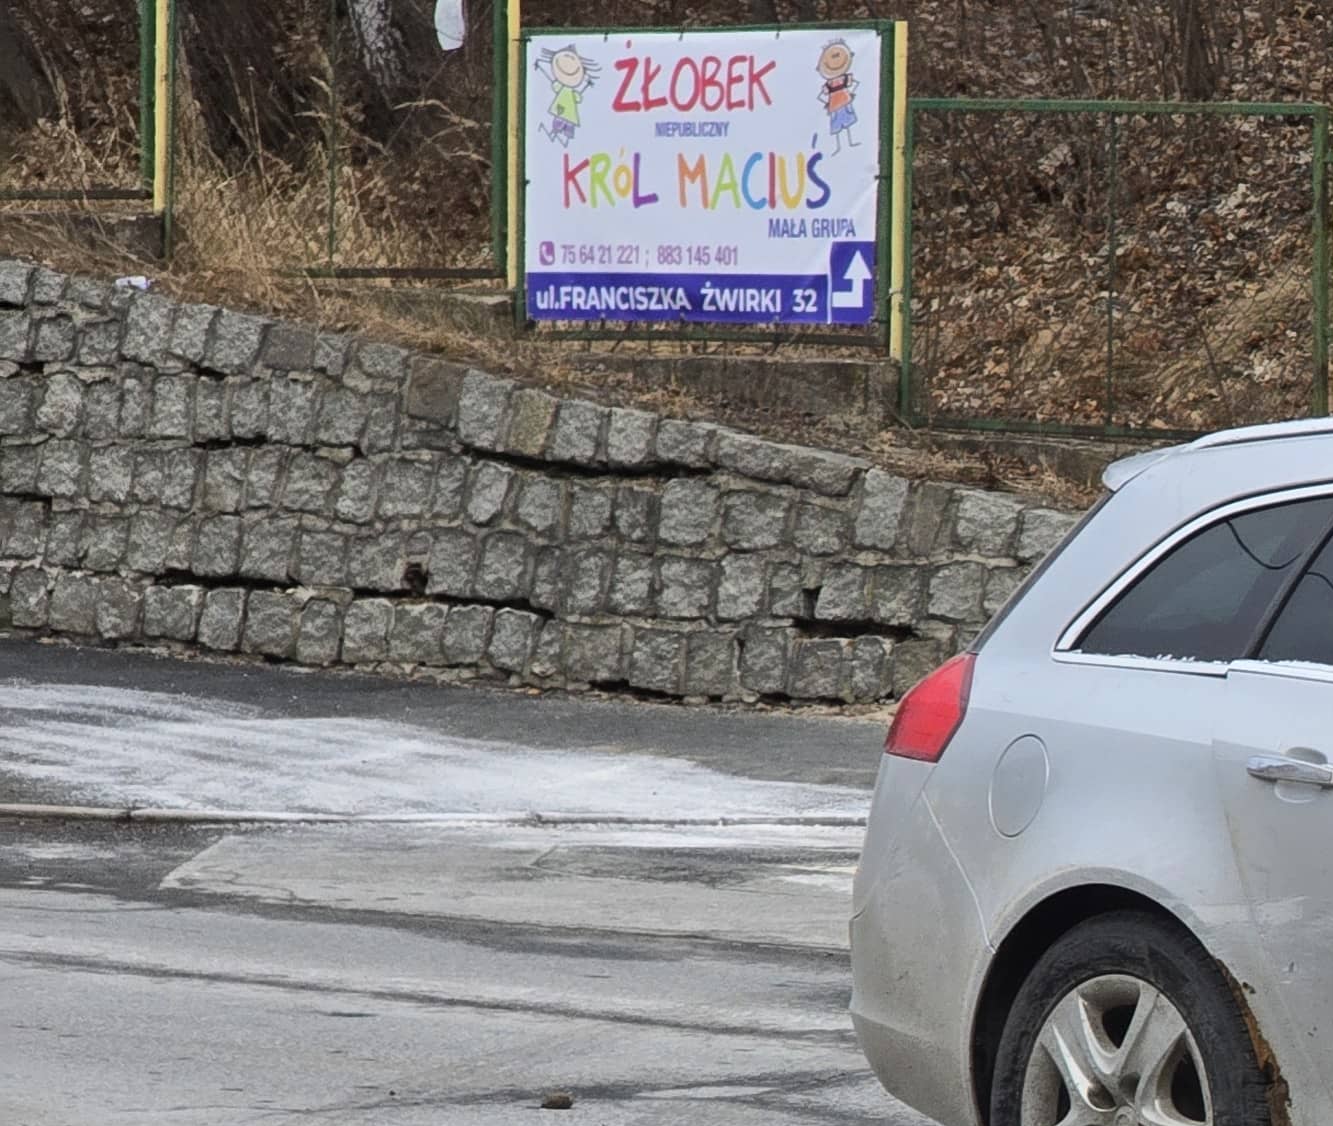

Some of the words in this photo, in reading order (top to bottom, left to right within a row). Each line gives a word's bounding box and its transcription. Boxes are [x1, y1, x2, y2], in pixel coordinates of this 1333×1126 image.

[612, 40, 776, 112] ŻŁOBEK
[654, 121, 730, 137] NIEPUBLICZNY
[563, 148, 659, 209] KRÓL
[676, 133, 831, 210] MACIUŚ
[768, 218, 808, 238] MAŁA
[811, 218, 857, 238] GRUPA
[560, 244, 576, 264] 75
[579, 244, 595, 265] 64
[599, 245, 612, 265] 21
[616, 245, 640, 265] 221
[656, 245, 683, 265] 883
[687, 245, 711, 266] 145
[714, 245, 739, 266] 401
[536, 285, 692, 311] ul.FRANCISZKA
[700, 281, 782, 313] ŻWIRKI
[791, 288, 818, 313] 32
